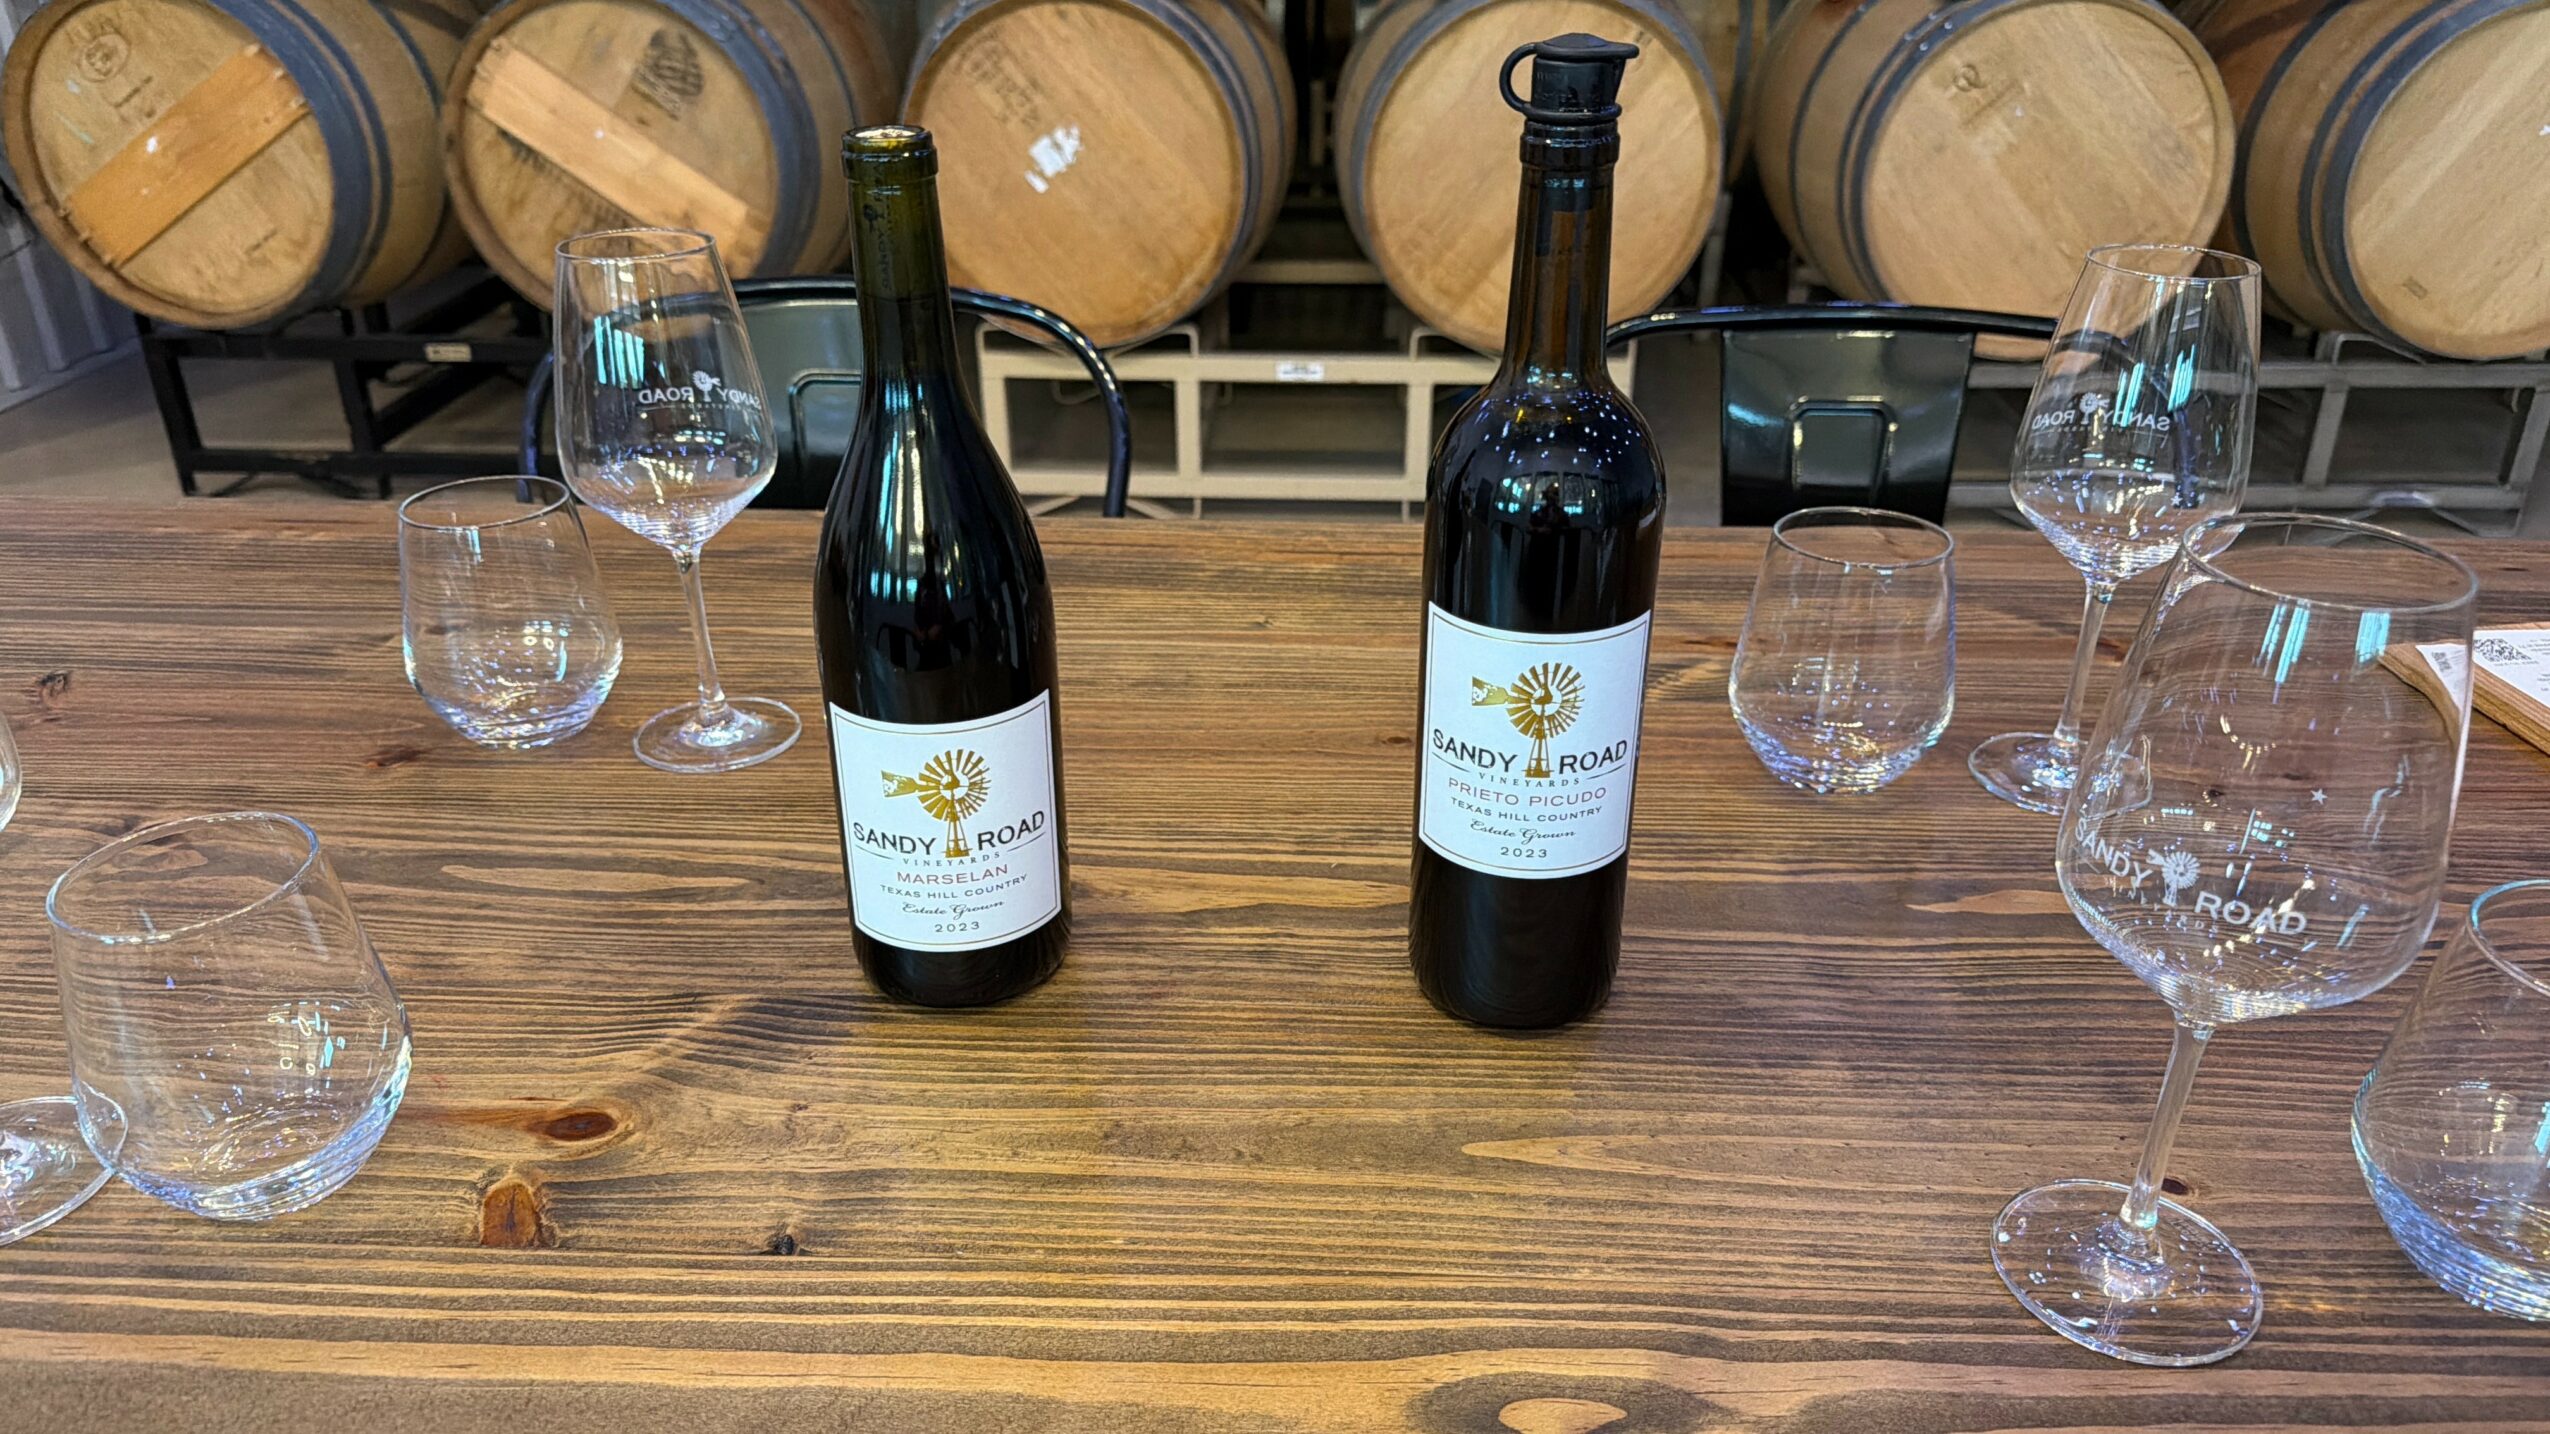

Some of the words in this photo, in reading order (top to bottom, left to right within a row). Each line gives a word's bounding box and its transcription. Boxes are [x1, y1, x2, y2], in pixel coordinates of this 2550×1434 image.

[1433, 728, 1518, 773] SANDY
[1558, 739, 1628, 775] ROAD
[1448, 777, 1519, 806] PRIETO
[1529, 787, 1607, 807] PICUDO
[1479, 772, 1580, 788] VINEYARDS
[1451, 797, 1492, 817] TEXAS
[1498, 811, 1530, 822] HILL
[1537, 805, 1603, 822] COUNTRY
[853, 821, 937, 855] SANDY
[977, 810, 1045, 851] ROAD
[1470, 817, 1516, 838] Estate
[1519, 828, 1576, 845] Grown
[903, 851, 1000, 868] VINEYARDS
[1500, 846, 1548, 859] 2023
[880, 884, 921, 899] TEXAS
[927, 891, 958, 899] HILL
[964, 874, 1028, 897] COUNTRY
[897, 864, 1008, 885] MARSELAN
[2074, 817, 2153, 888] SANDY
[2194, 890, 2307, 935] ROAD
[902, 900, 948, 915] Estate
[950, 901, 1005, 921] Grown
[935, 921, 980, 933] 2023
